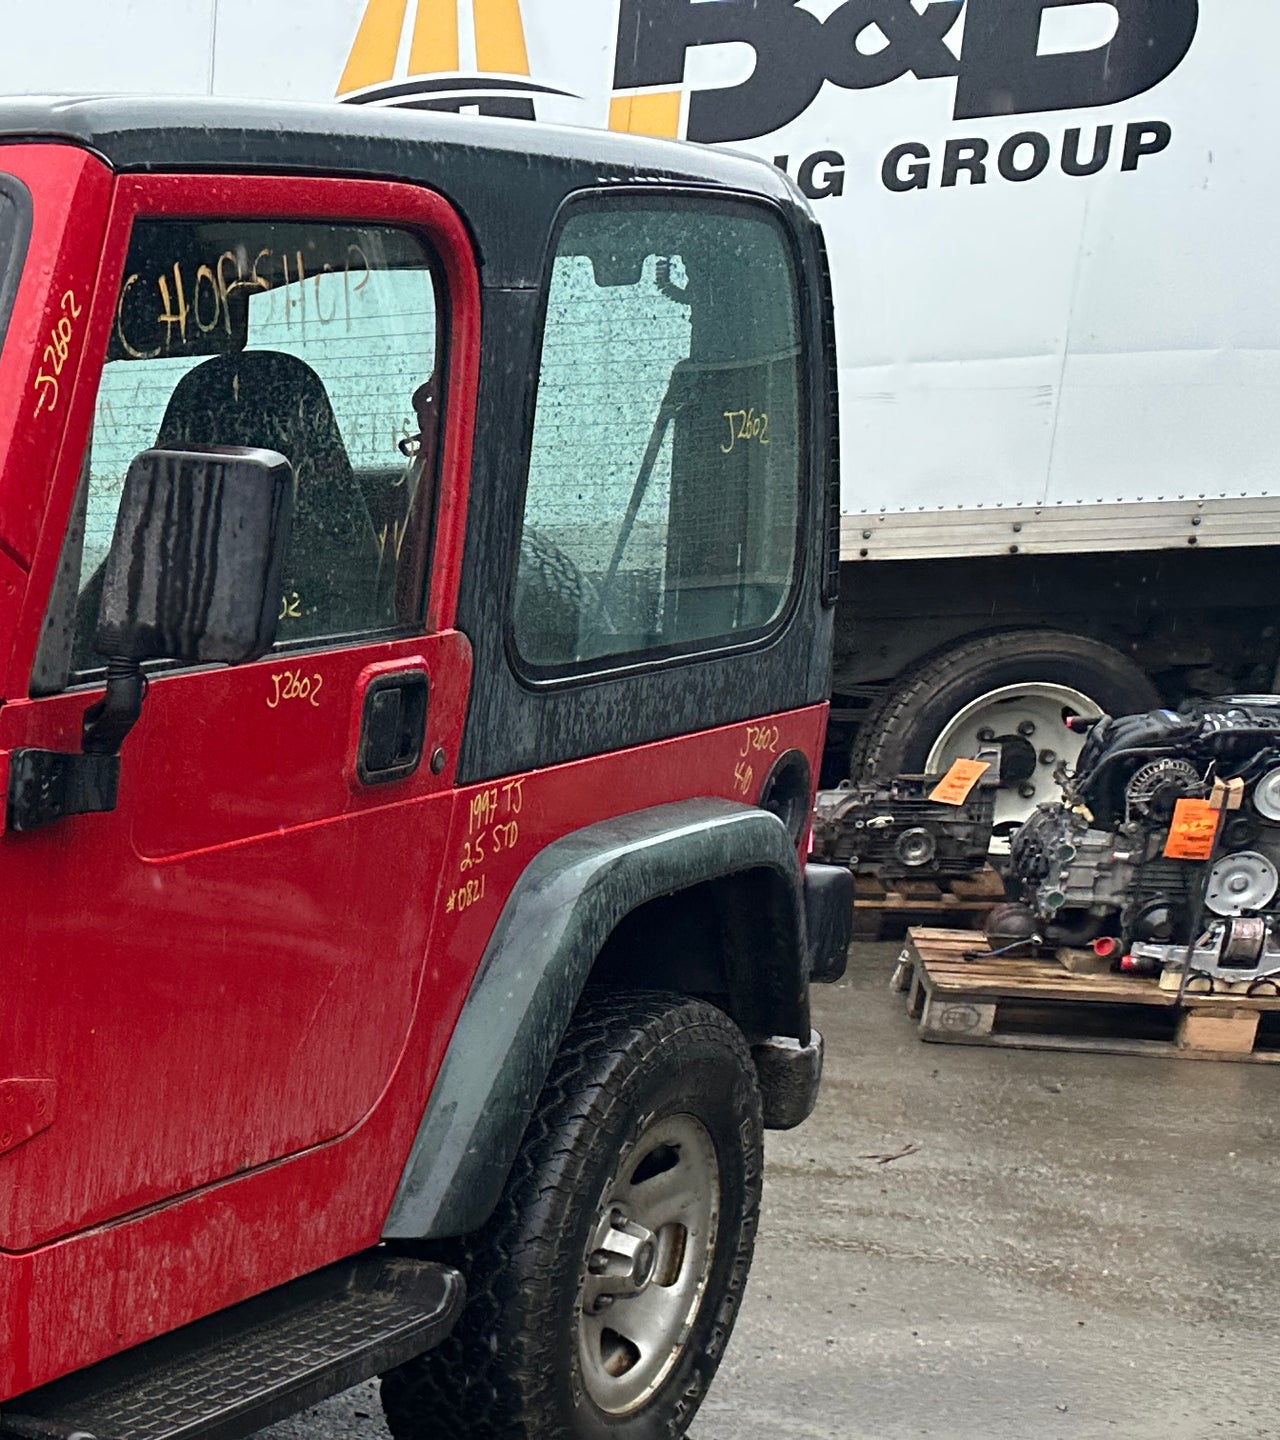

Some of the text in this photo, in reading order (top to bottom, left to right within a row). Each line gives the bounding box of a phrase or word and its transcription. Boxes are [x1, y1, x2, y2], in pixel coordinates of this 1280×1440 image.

[881, 120, 1172, 192] GROUP
[33, 289, 82, 412] J2602
[720, 407, 771, 453] J2602
[266, 668, 323, 708] J2602
[469, 778, 525, 835] 1997 TJ
[493, 820, 518, 852] STD
